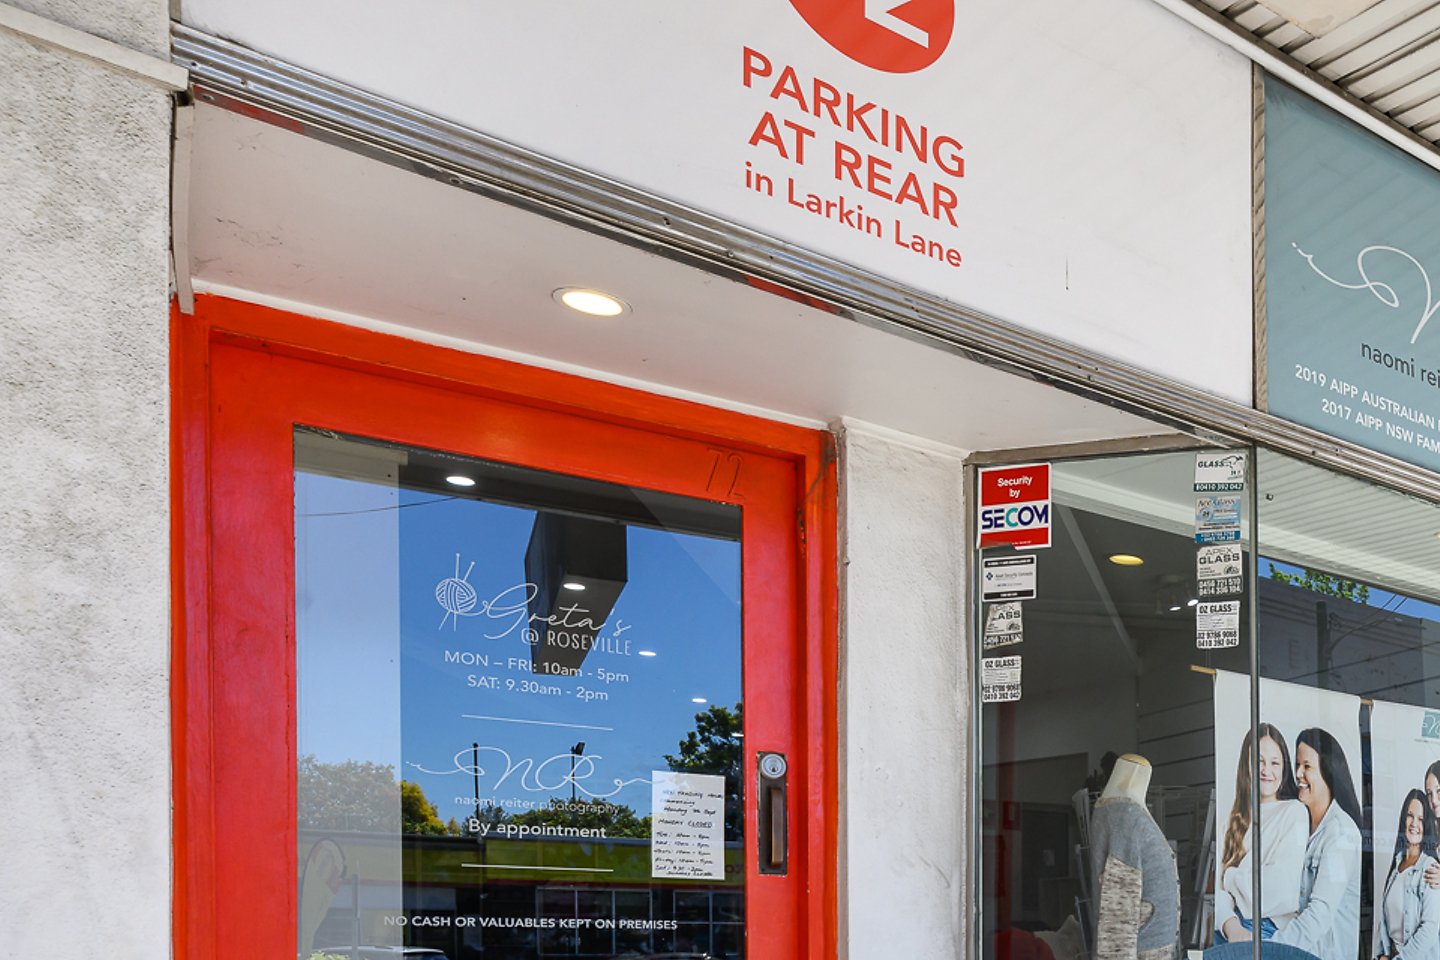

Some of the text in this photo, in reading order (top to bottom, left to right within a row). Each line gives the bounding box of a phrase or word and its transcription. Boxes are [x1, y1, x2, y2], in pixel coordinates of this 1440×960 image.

[743, 46, 965, 178] PARKING
[748, 111, 959, 228] AT REAR
[745, 161, 962, 268] in Larkin Lane
[1361, 342, 1415, 378] naomi
[1295, 363, 1327, 387] 2019
[1330, 378, 1358, 398] AIPP
[1361, 391, 1435, 429] AUSTRALIAN
[1322, 398, 1352, 420] 2017
[1355, 411, 1383, 431] AIPP
[1386, 422, 1414, 444] NSW
[1198, 460, 1225, 469] GLASS
[997, 475, 1033, 488] Security
[1009, 488, 1021, 498] by
[982, 504, 1049, 530] SECOM
[1199, 553, 1240, 565] GLASS
[482, 582, 632, 640] Greta's
[1210, 604, 1232, 613] GLASS
[521, 628, 632, 656] @ ROSEVILLE
[444, 650, 489, 667] MON
[508, 657, 537, 673] FRI:
[542, 662, 583, 677] 10am
[597, 668, 629, 684] 5pm
[995, 658, 1016, 668] GLASS
[467, 675, 501, 689] SAT:
[505, 679, 562, 696] 9.30am
[576, 687, 609, 702] 2pm
[455, 796, 620, 815] naomi reiter photography
[468, 818, 607, 839] By appointment
[384, 916, 678, 931] NO CASH OR VALUABLES KEPT ON PREMISES
